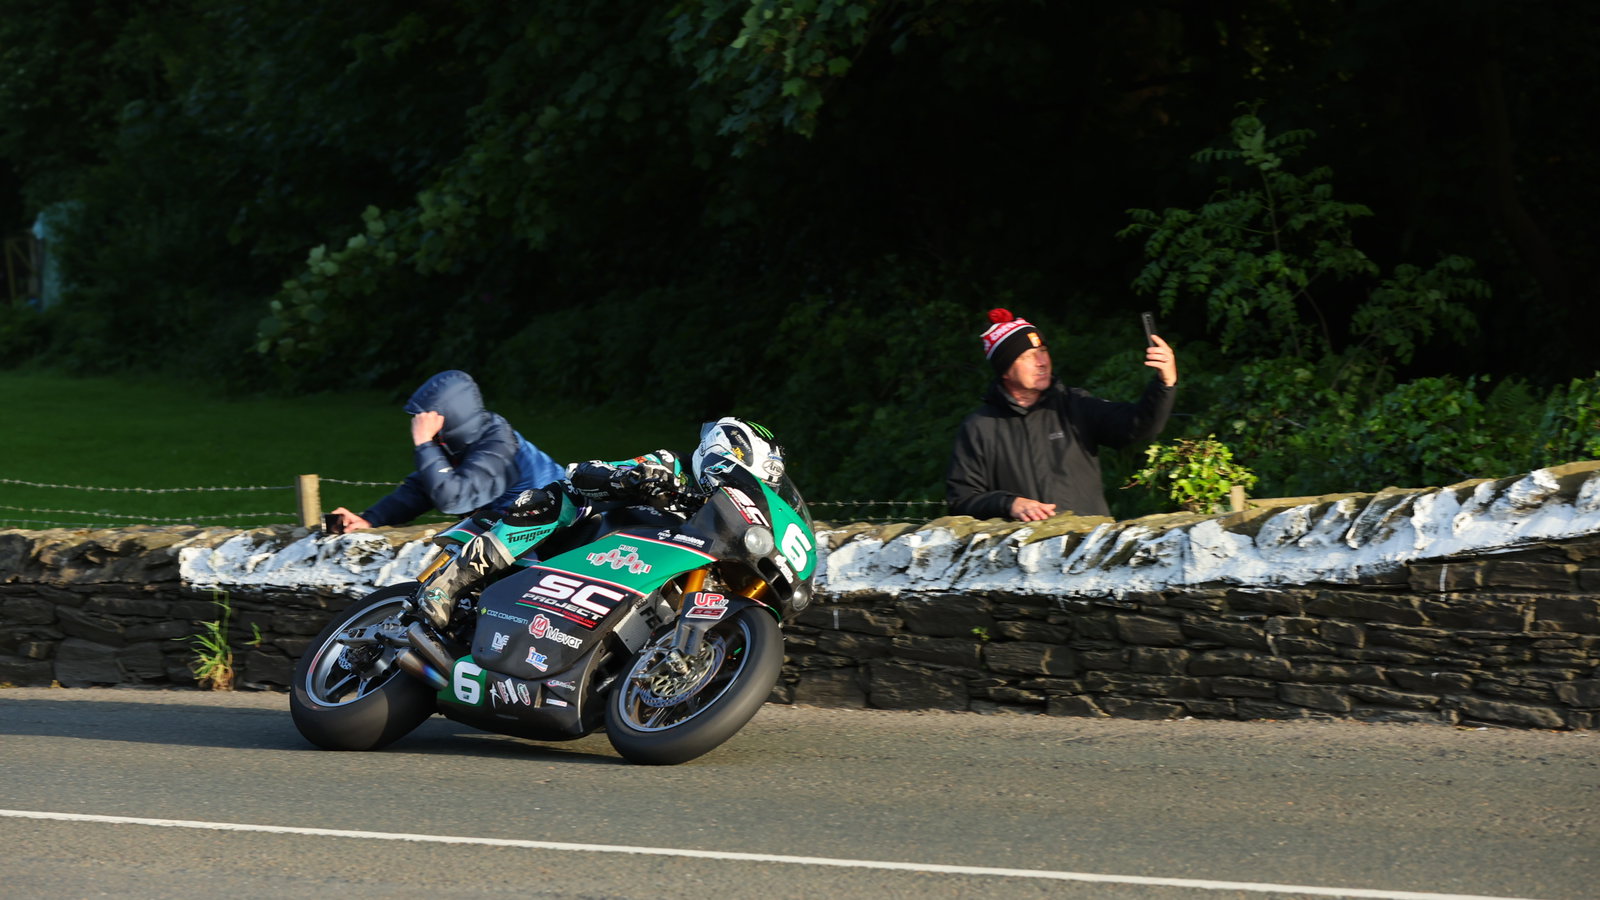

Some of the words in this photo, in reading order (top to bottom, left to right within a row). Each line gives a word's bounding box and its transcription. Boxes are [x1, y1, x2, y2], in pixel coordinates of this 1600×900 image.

[506, 527, 552, 543] Furygan
[781, 523, 812, 572] 6
[596, 551, 642, 571] PATON
[521, 593, 603, 620] PROJECT
[529, 574, 625, 616] SC
[695, 592, 724, 606] UP
[545, 626, 583, 649] Mevar
[453, 661, 482, 704] 6
